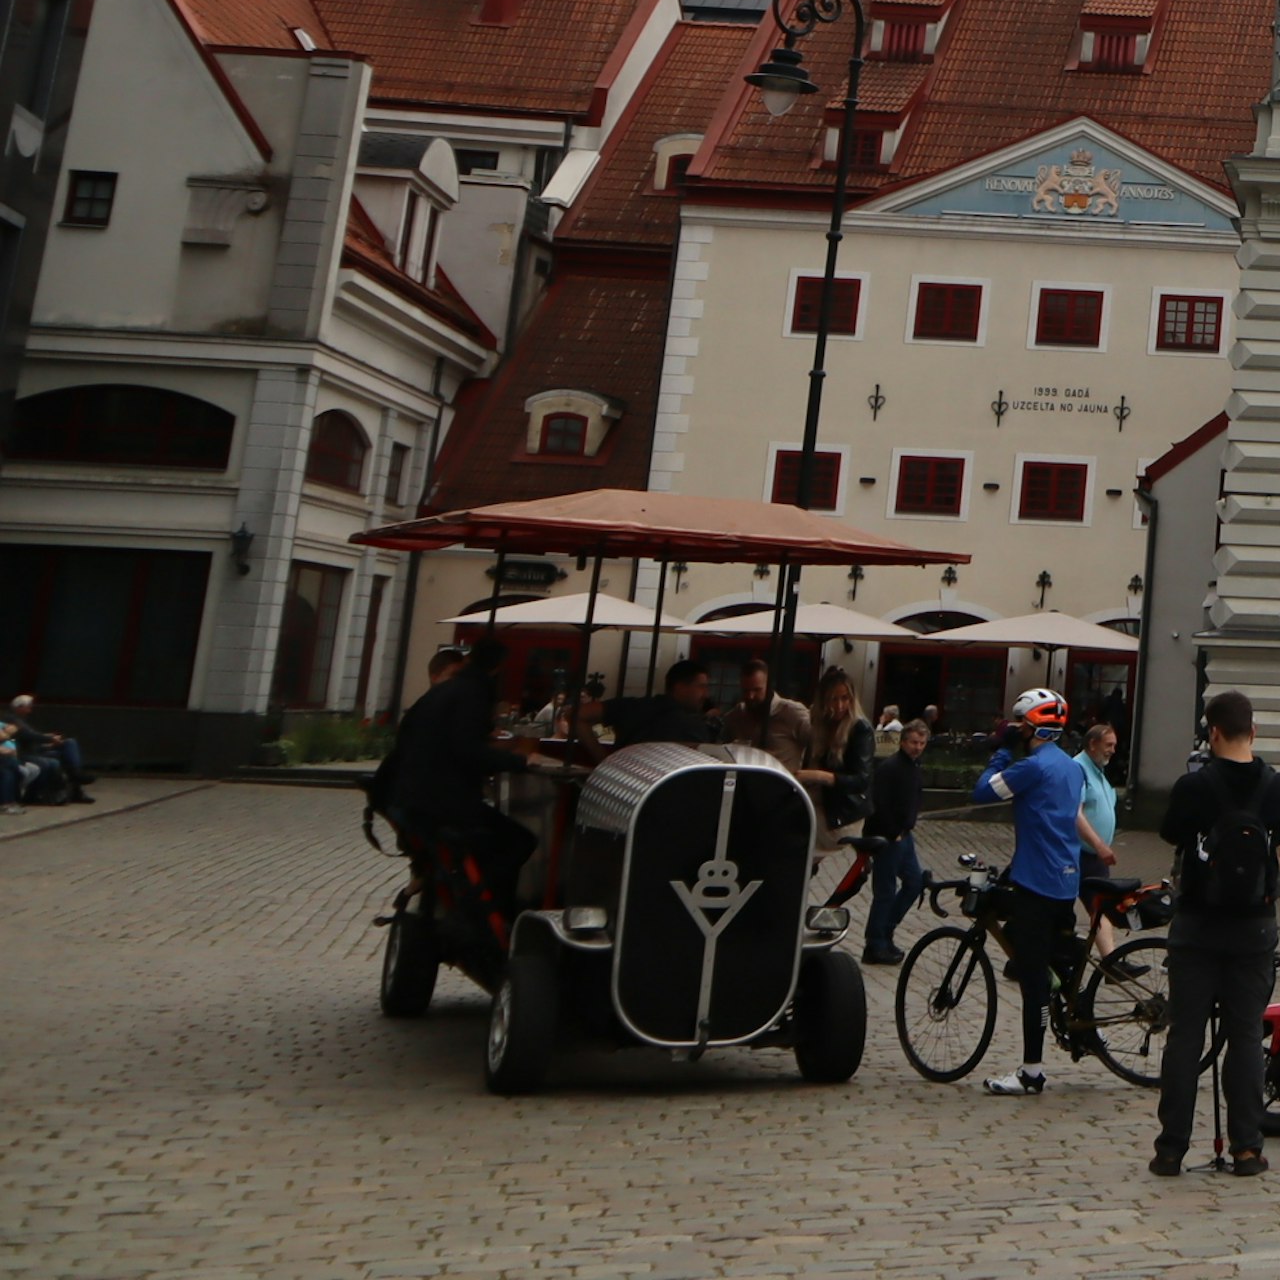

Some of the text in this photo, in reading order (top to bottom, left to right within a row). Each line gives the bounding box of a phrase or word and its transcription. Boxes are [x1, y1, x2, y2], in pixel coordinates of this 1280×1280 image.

[1012, 401, 1109, 413] UZCELTA NO JAUNA
